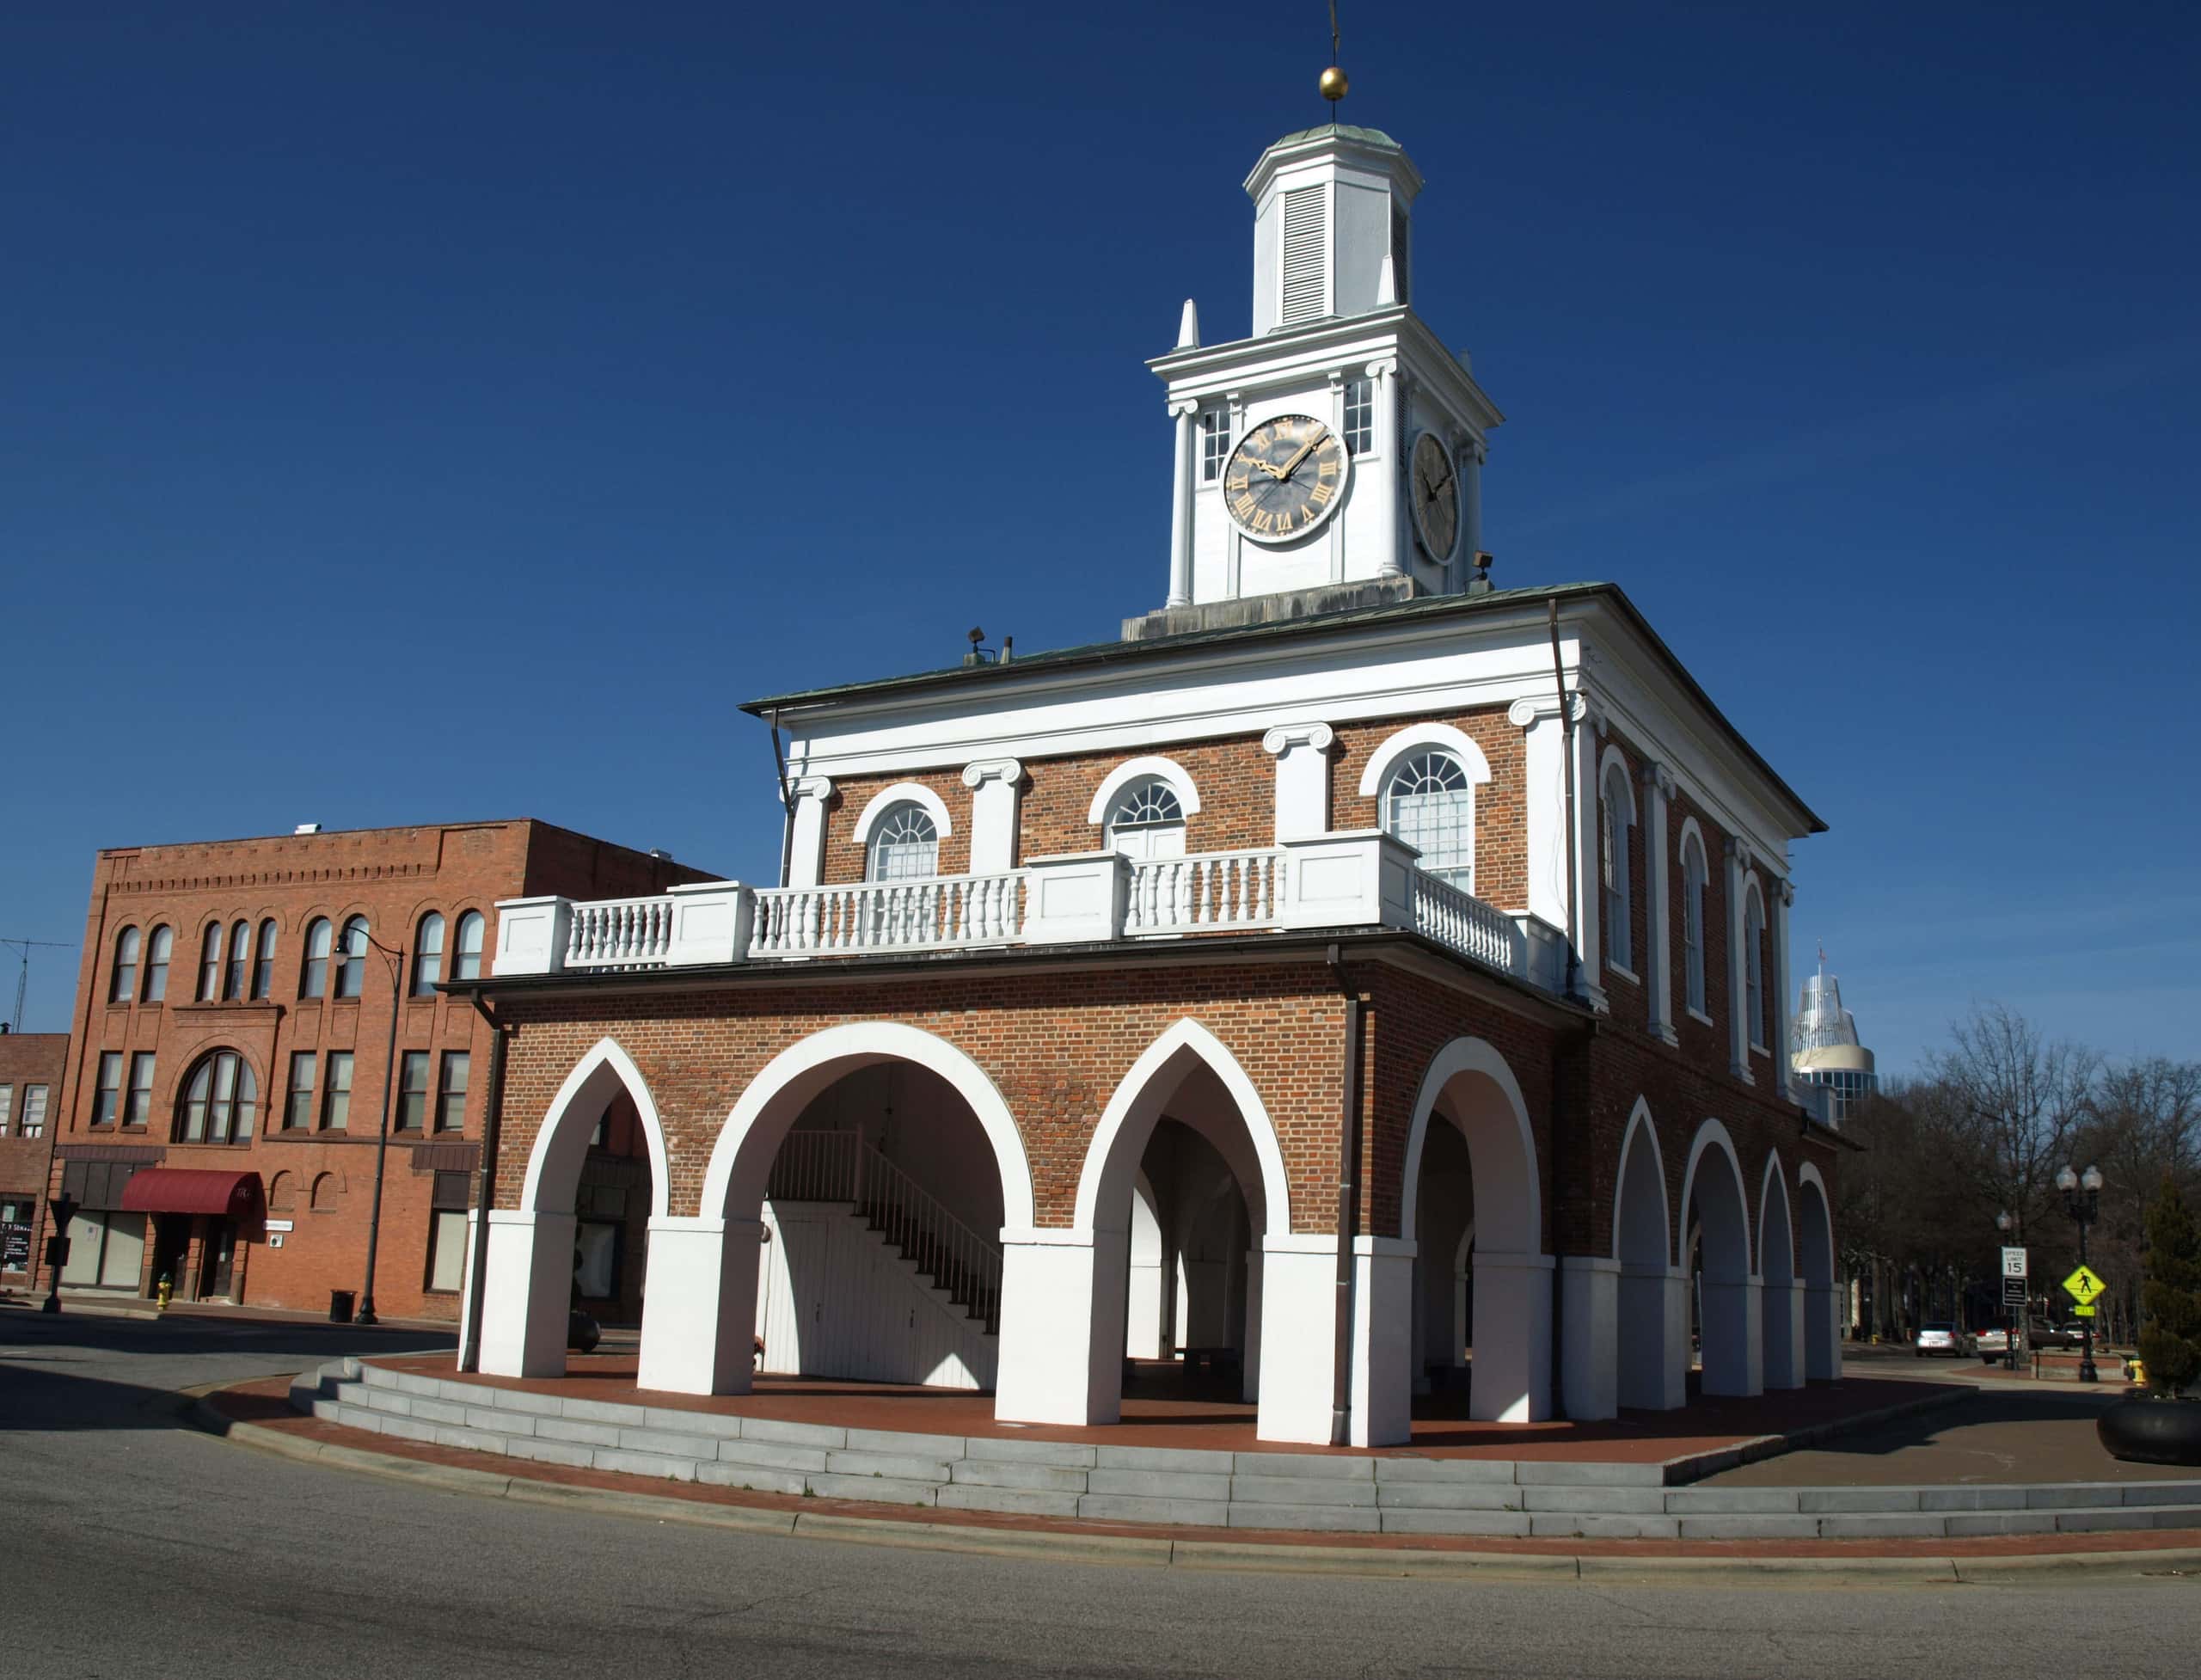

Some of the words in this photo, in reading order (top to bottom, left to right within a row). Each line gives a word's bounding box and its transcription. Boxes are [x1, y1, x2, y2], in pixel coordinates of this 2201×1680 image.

[1319, 461, 1337, 479] III
[1230, 474, 1248, 493] IX
[1251, 508, 1273, 531] VII
[1275, 511, 1294, 531] VI
[1300, 504, 1315, 523] V
[2008, 1262, 2022, 1272] 15
